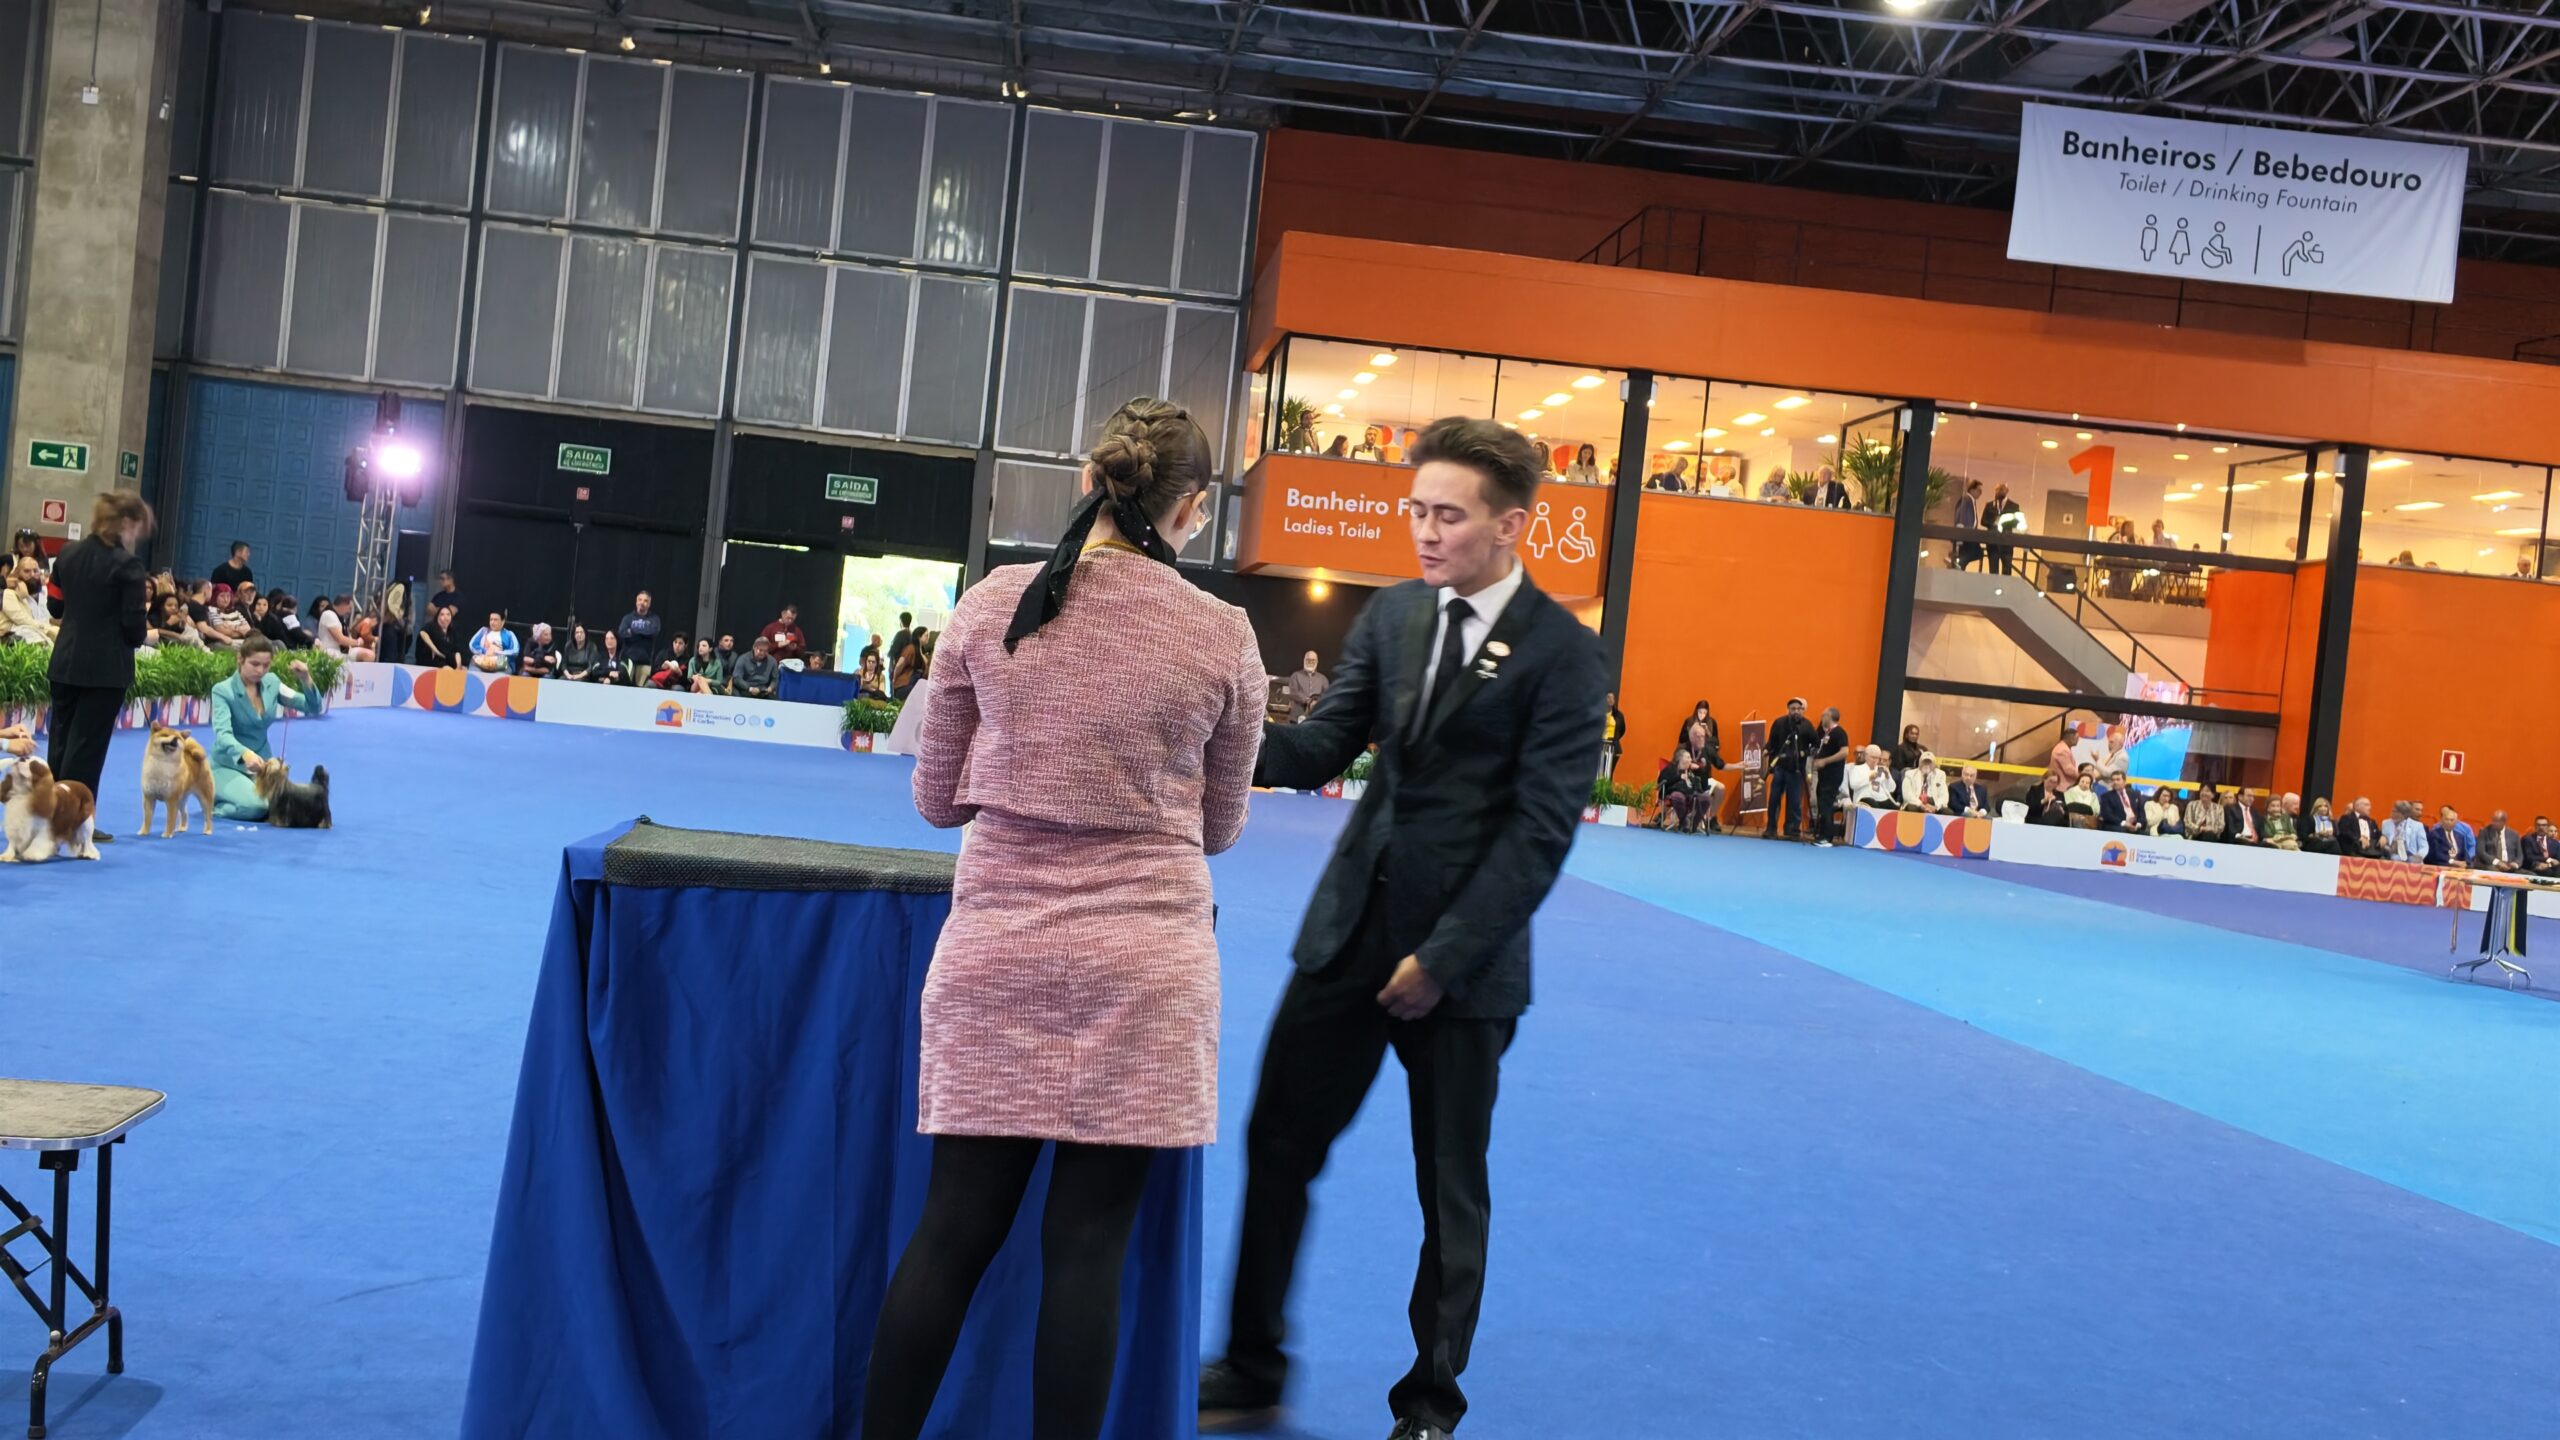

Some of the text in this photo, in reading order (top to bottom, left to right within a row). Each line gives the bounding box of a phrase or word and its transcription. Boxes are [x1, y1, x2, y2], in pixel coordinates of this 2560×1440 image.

[2062, 130, 2422, 192] Banheiros / Bebedouro
[2119, 171, 2358, 214] Toilet / Drinking Fountain
[1286, 488, 1389, 516] Banheiro
[2068, 445, 2115, 527] 1
[1284, 517, 1381, 540] Ladies Toilet
